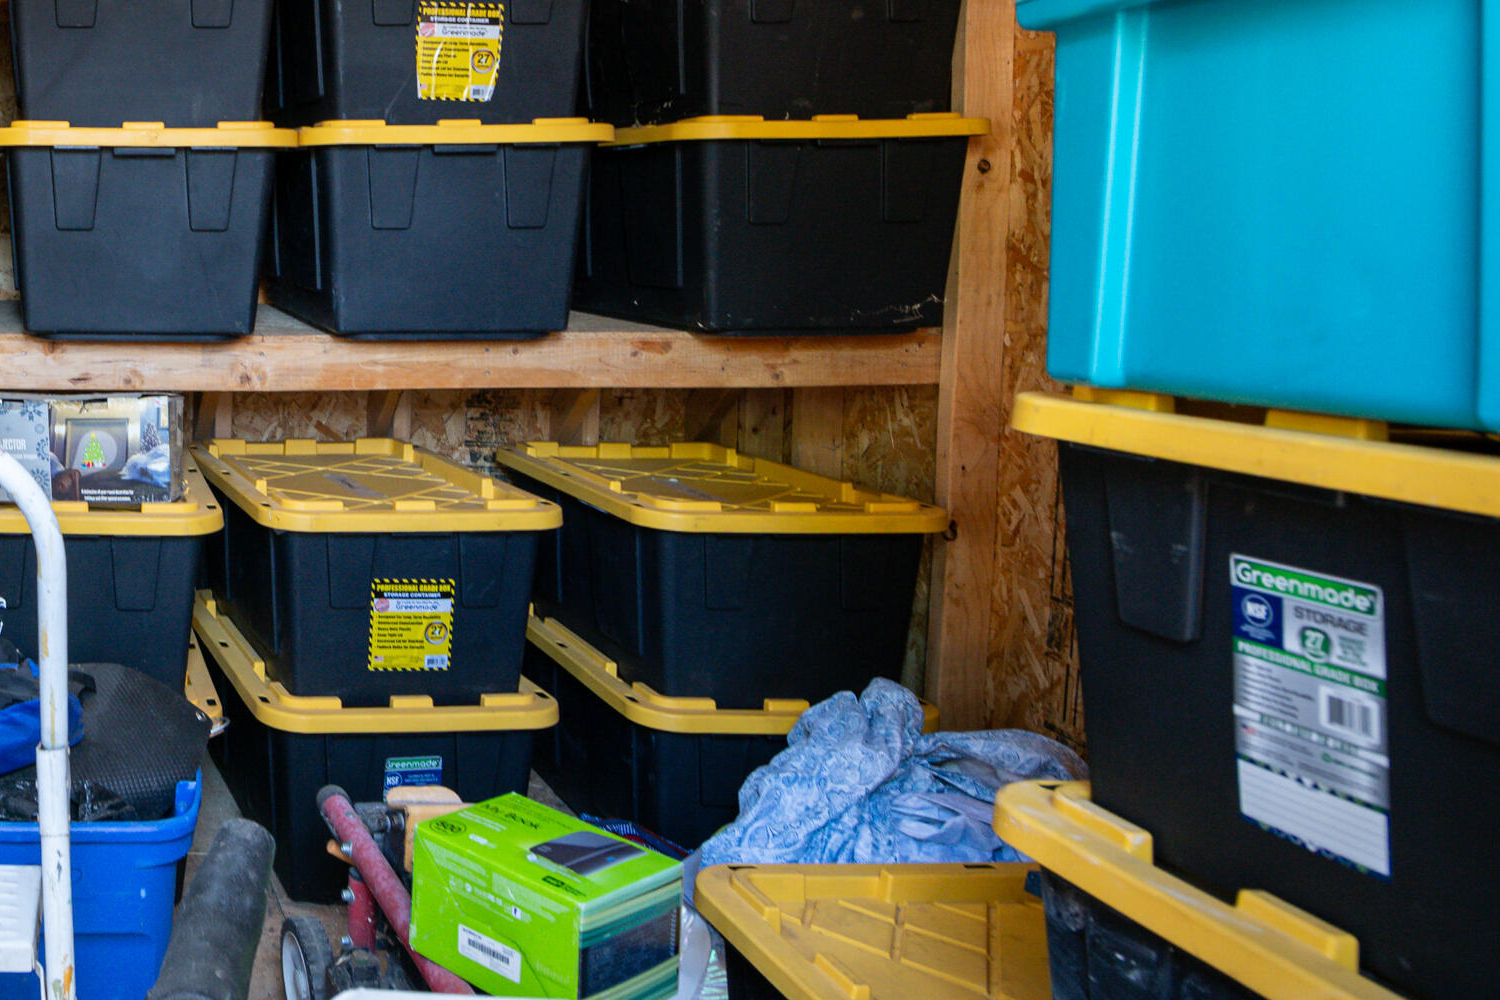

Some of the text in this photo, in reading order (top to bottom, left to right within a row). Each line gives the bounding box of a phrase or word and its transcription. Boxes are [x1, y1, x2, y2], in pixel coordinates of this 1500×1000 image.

[423, 7, 466, 16] PROFESSIONAL
[487, 9, 501, 18] BOX
[442, 28, 486, 36] Greenmade
[477, 54, 490, 64] 27
[376, 584, 451, 592] PROFESSIONAL GRADE BOX
[1235, 562, 1372, 613] Greenmade
[1246, 600, 1268, 620] NSF
[1294, 605, 1368, 636] STORAGE
[431, 625, 443, 635] 27
[1304, 630, 1325, 650] 27
[1237, 641, 1380, 693] PROFESSIONAL GRADE BOX
[386, 759, 438, 769] Greenmade
[386, 775, 400, 785] NSF
